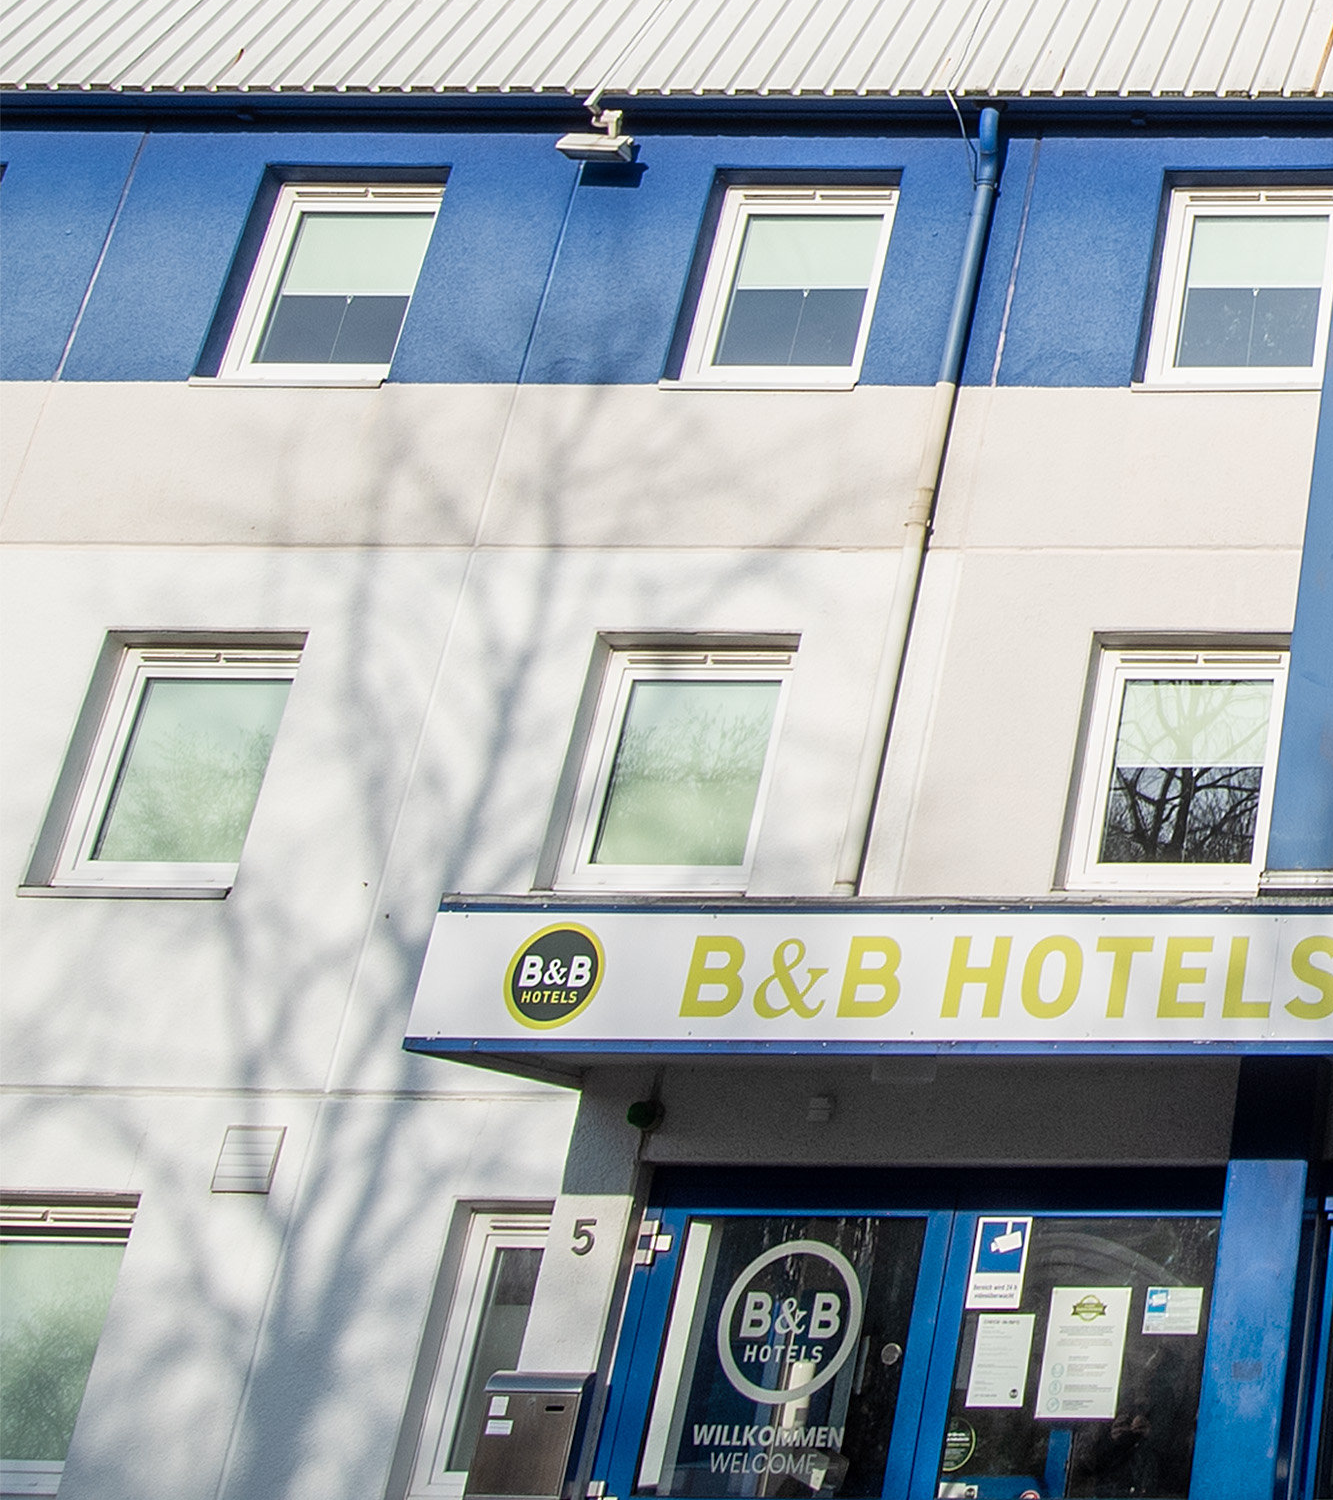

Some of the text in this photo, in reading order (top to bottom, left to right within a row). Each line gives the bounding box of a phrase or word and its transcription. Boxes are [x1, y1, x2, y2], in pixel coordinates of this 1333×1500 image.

[518, 955, 592, 987] B&B
[678, 935, 902, 1019] B&B
[520, 991, 578, 1003] HOTELS
[571, 1219, 597, 1256] 5
[739, 1291, 841, 1339] B&B
[743, 1345, 823, 1363] HOTELS
[693, 1424, 845, 1448] WILLKOMMEN
[710, 1452, 817, 1474] WELCOME
